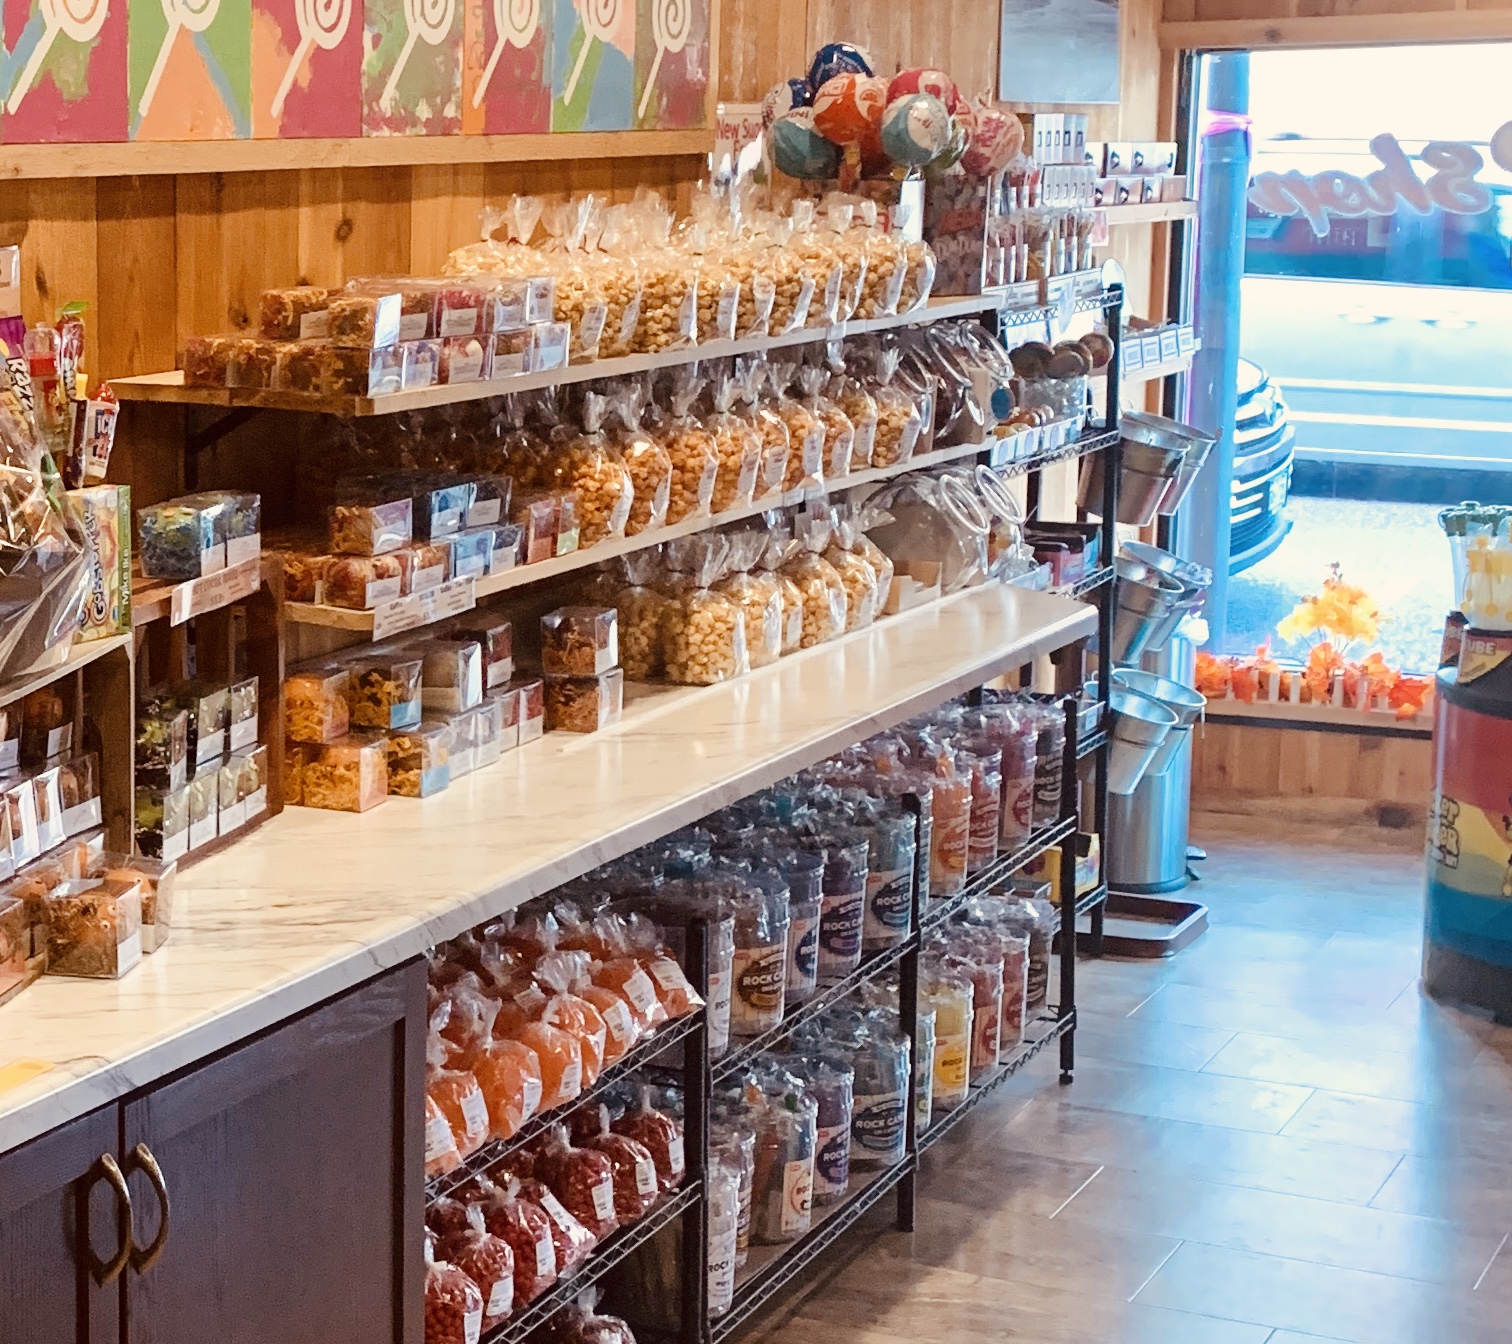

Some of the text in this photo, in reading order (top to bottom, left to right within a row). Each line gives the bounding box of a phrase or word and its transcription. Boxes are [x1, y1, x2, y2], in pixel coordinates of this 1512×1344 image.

[717, 119, 739, 140] New
[875, 895, 901, 906] ROCK
[822, 920, 848, 931] ROCK
[742, 974, 772, 986] ROCK
[854, 1119, 884, 1129] ROCK
